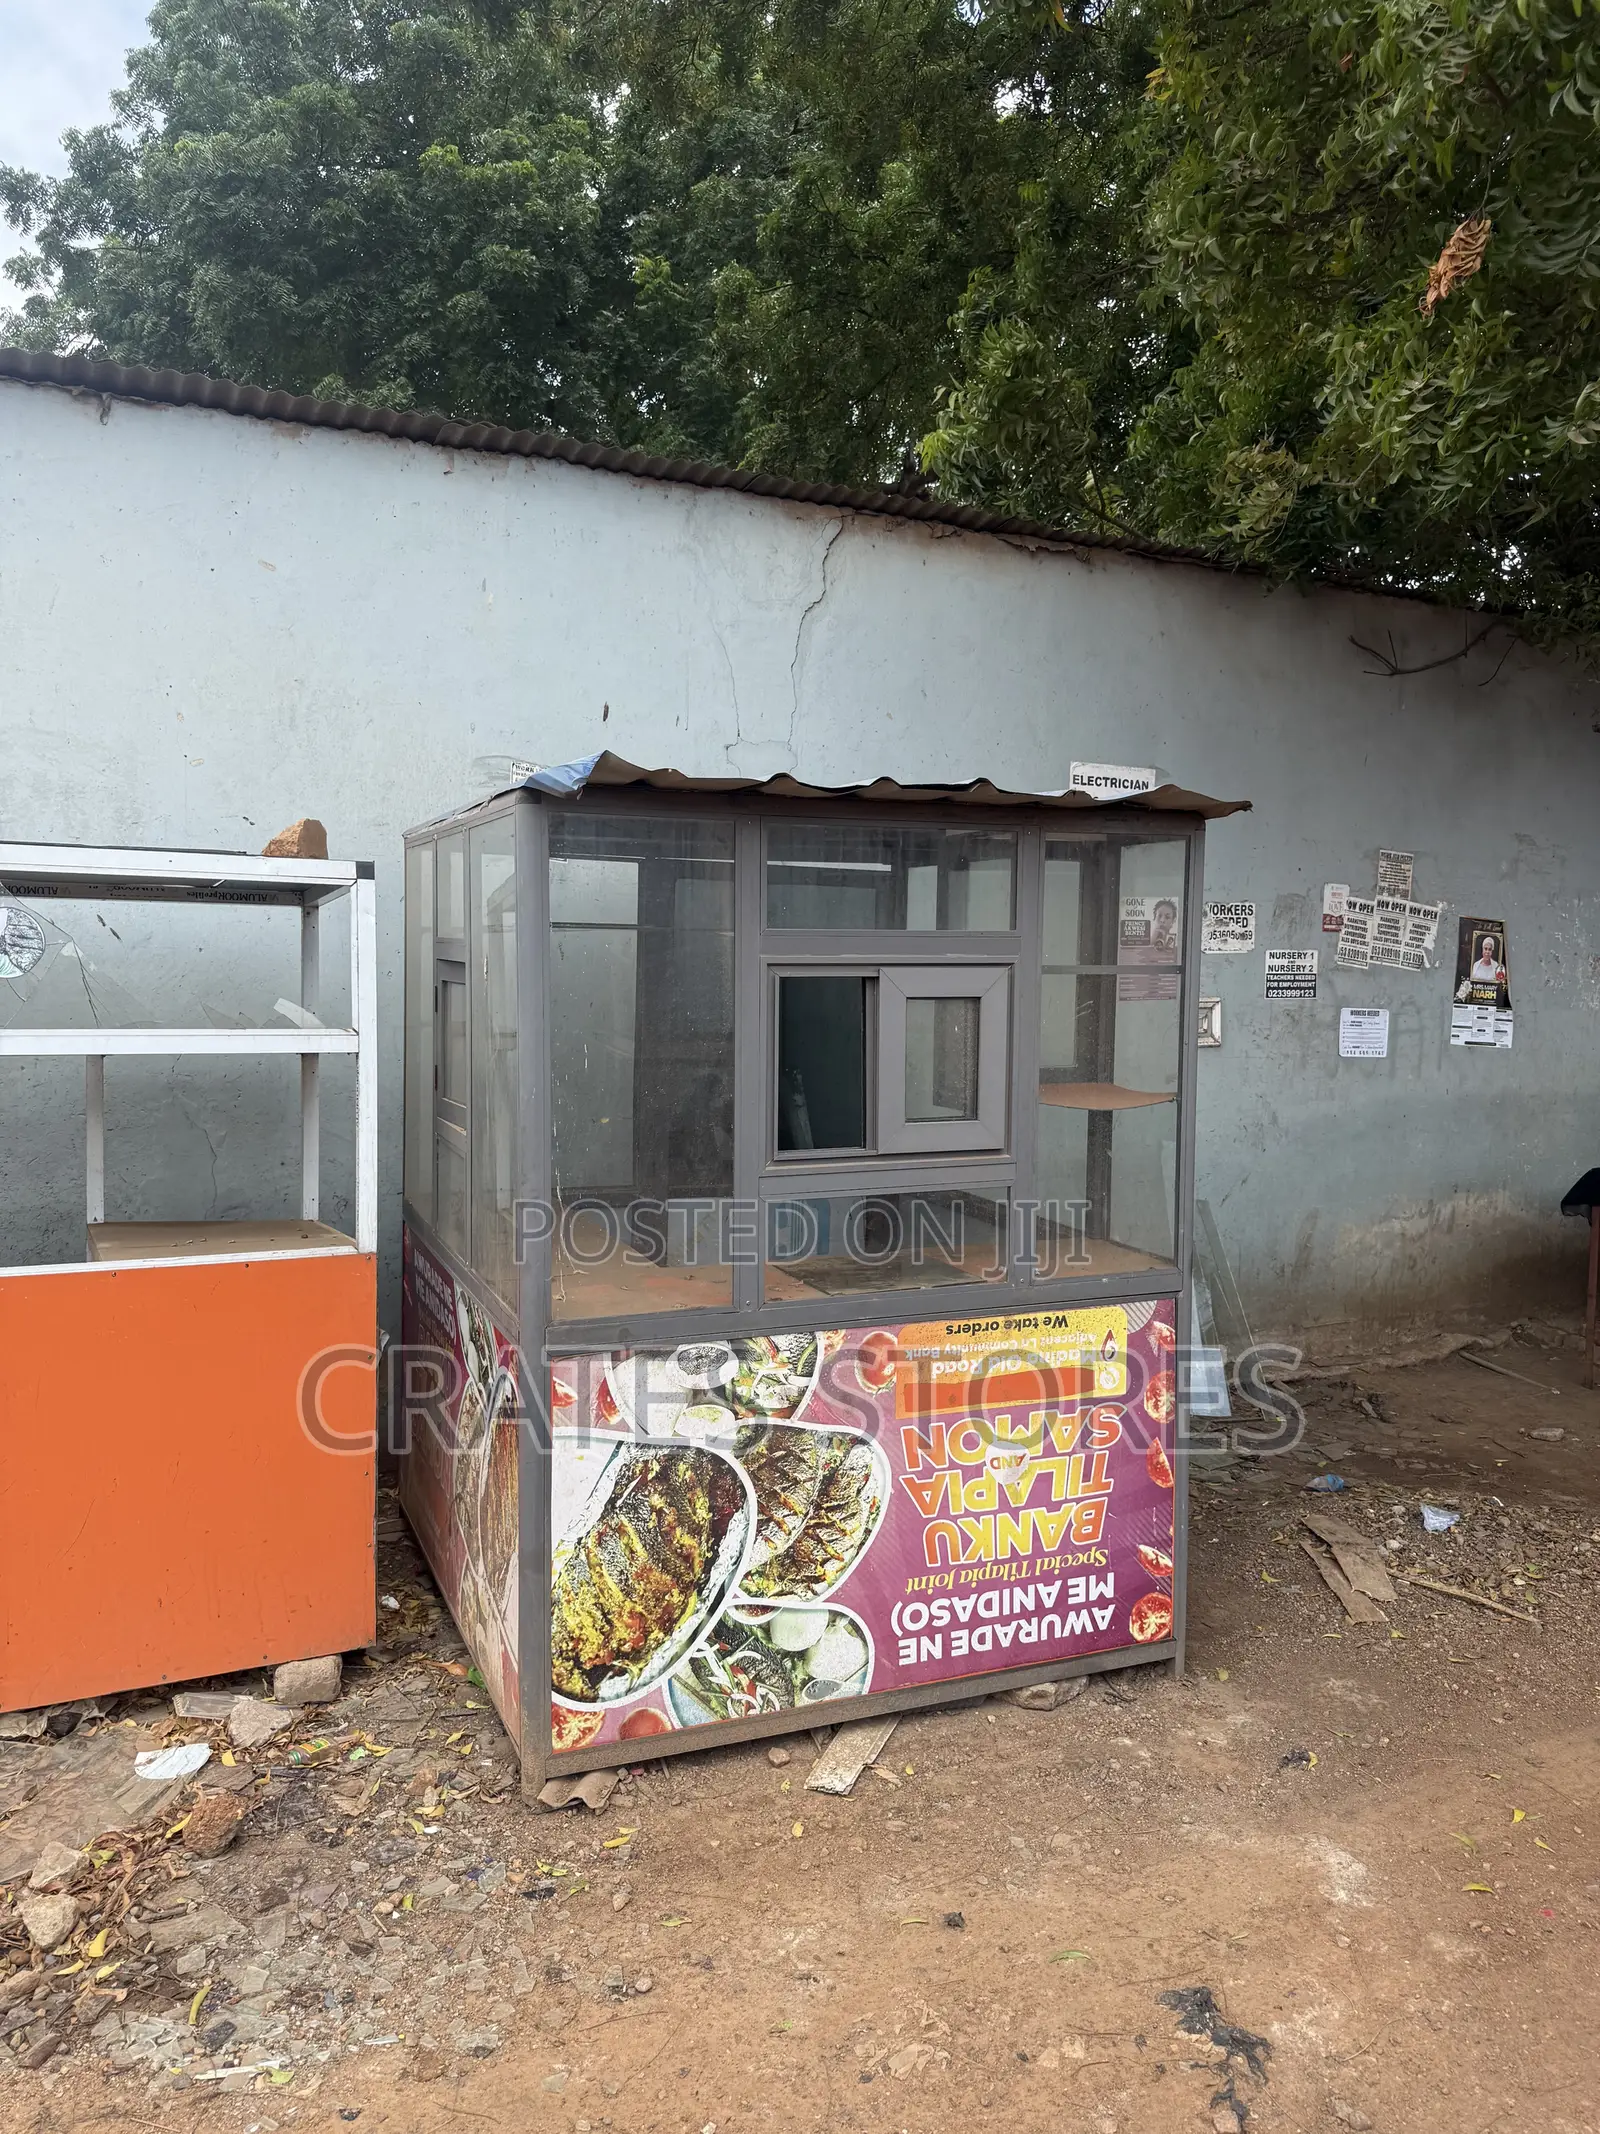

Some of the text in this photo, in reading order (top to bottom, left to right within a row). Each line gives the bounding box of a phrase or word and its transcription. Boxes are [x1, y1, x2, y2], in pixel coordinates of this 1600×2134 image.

[1072, 774, 1149, 790] ELECTRICIAN
[1126, 898, 1146, 906] GONE
[1359, 901, 1375, 914] OPEN
[1377, 899, 1407, 913] NOW OPEN
[1125, 909, 1145, 917] SOON
[1409, 906, 1421, 916] NOW
[1422, 908, 1438, 920] OPEN
[1269, 952, 1314, 960] NURSERY 1
[1268, 964, 1314, 973] NURSERY 2
[1268, 989, 1314, 998] 0233999123
[1472, 990, 1497, 1000] NARH
[945, 1315, 1069, 1336] We take orders
[905, 1347, 941, 1361] Bank
[944, 1340, 1019, 1357] Community
[931, 1345, 1097, 1379] Madina Old Road
[900, 1402, 1127, 1471] SAMON
[989, 1453, 1026, 1470] AND
[899, 1450, 1114, 1518] TILAPIA
[922, 1497, 1108, 1567] BANKU
[905, 1549, 1109, 1595] Special Tilapia Joint
[891, 1572, 1115, 1637] ME ANIDASO)
[898, 1604, 1116, 1666] AWURADE NE
